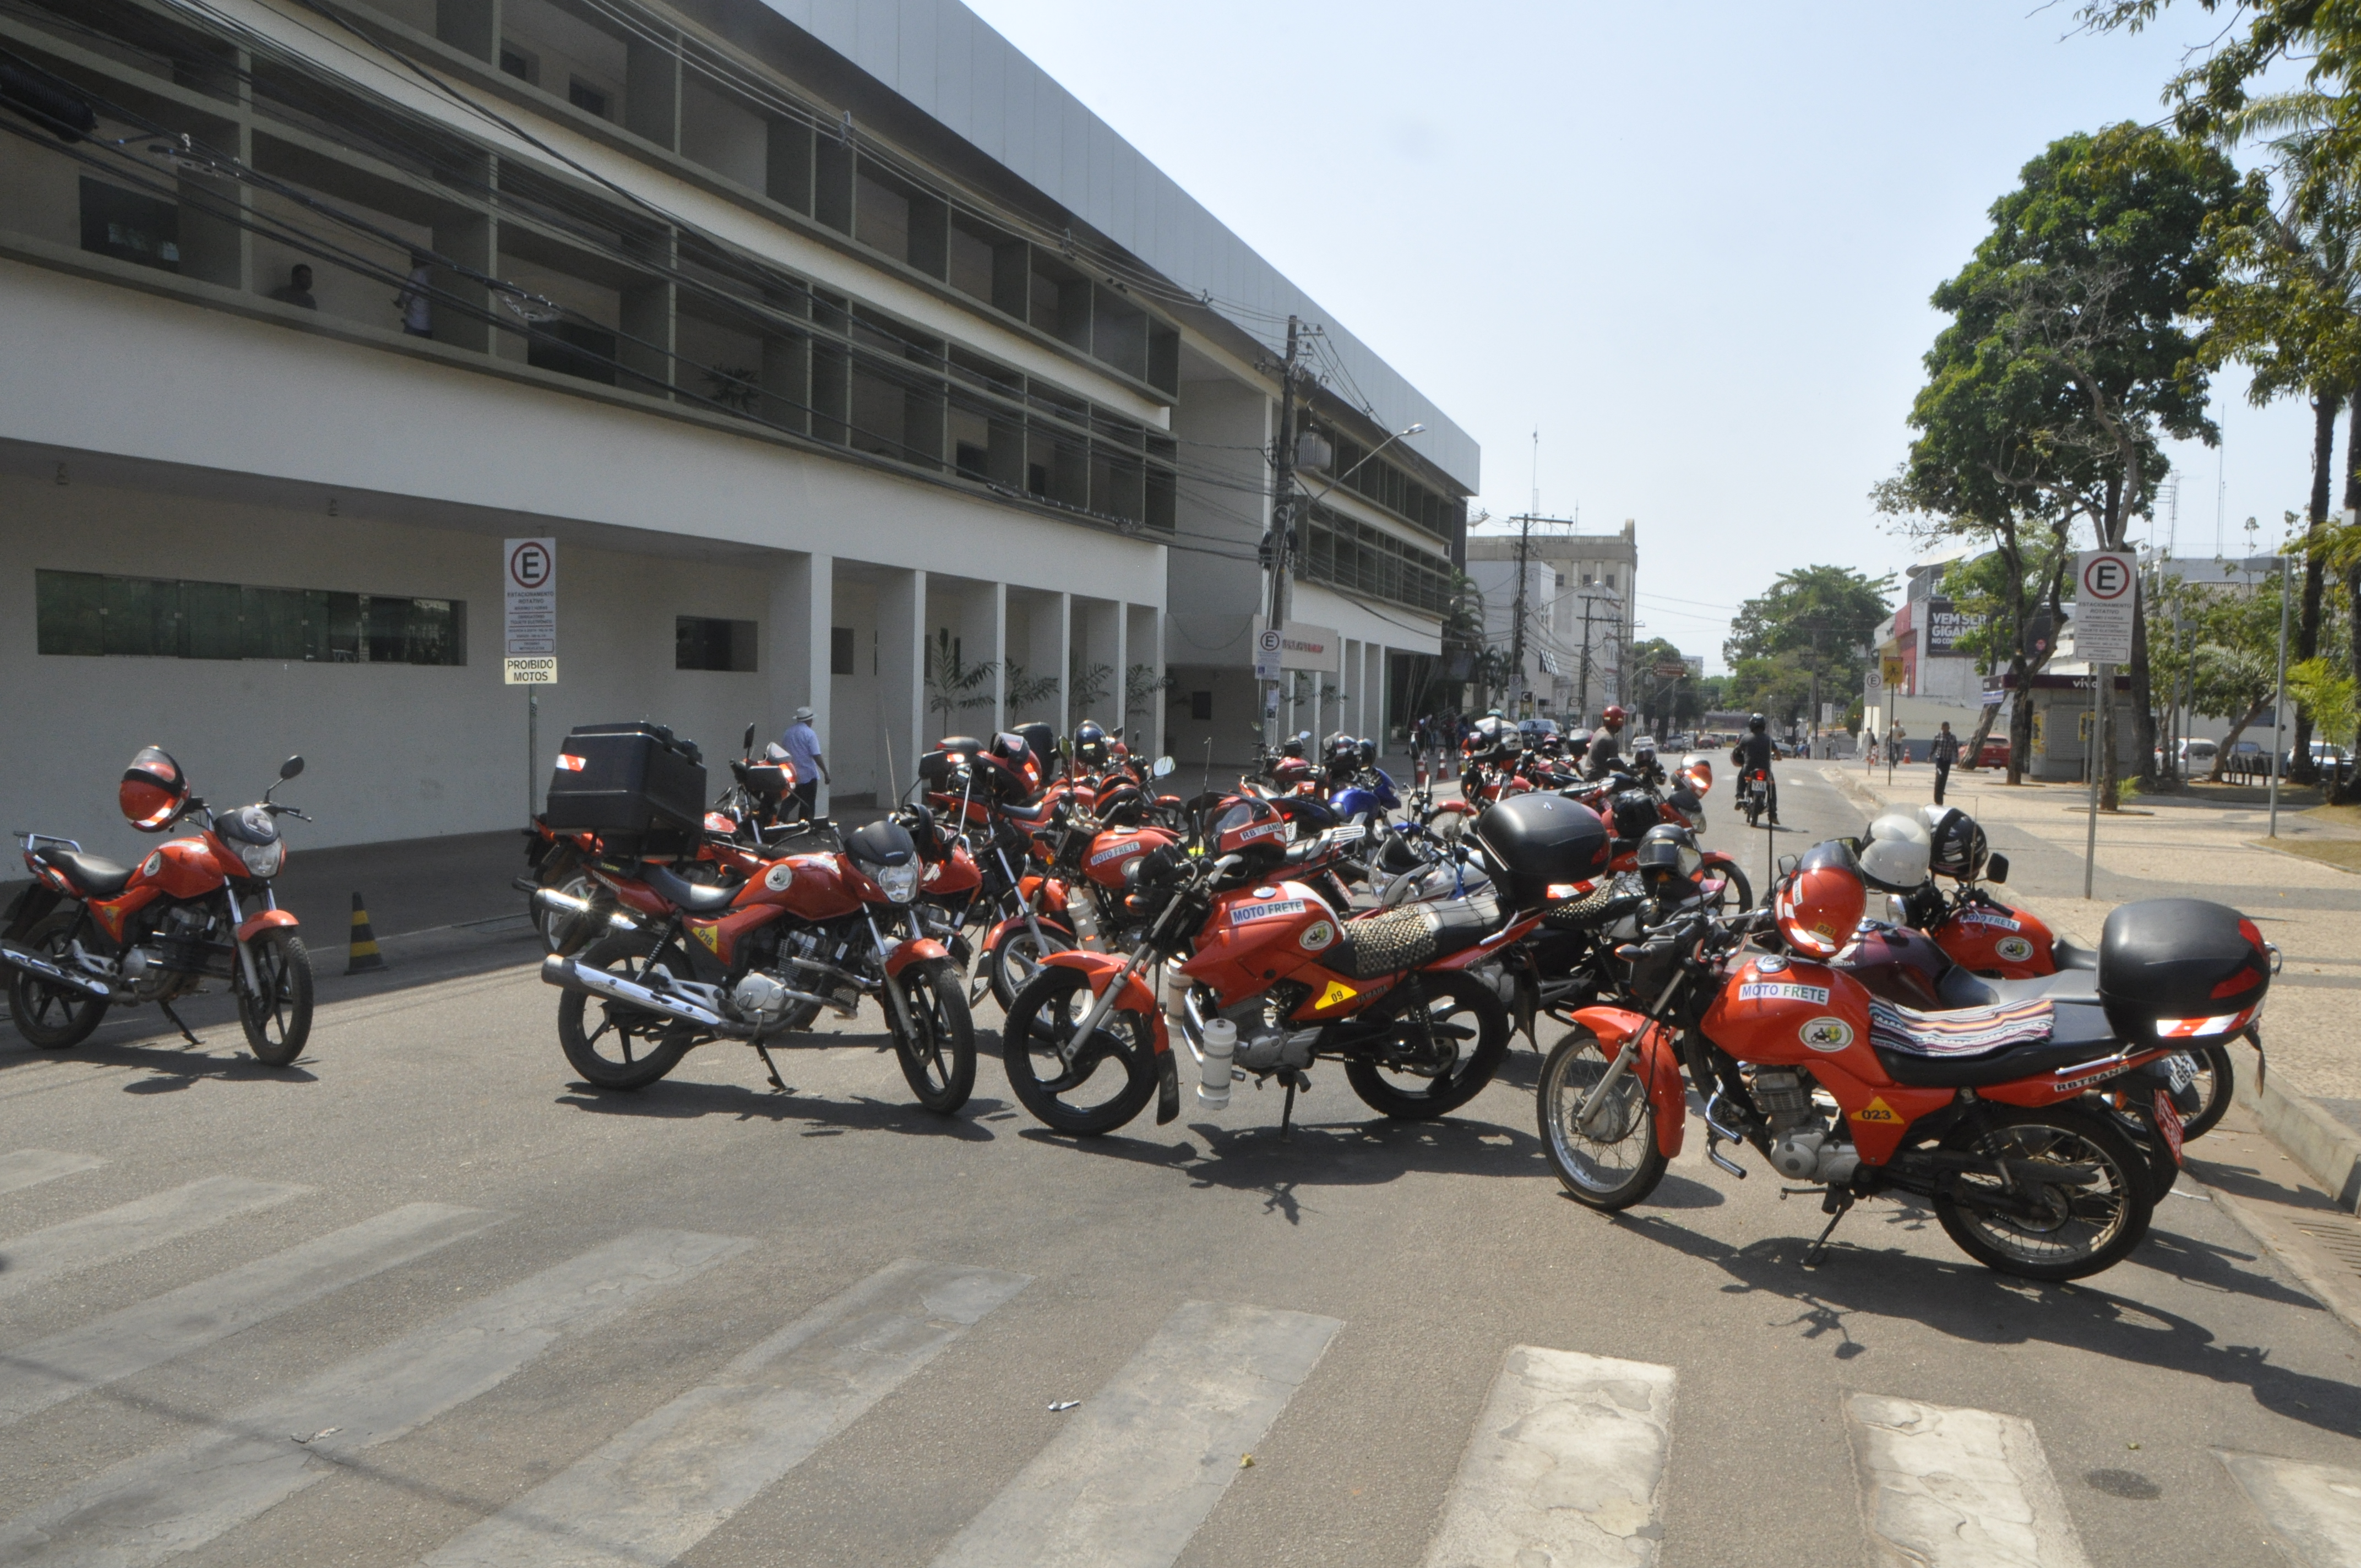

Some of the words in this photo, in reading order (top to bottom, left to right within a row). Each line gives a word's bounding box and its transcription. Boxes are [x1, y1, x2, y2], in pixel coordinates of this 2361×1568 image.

[523, 552, 540, 579] E
[2097, 565, 2117, 590] E
[1933, 613, 1960, 625] VEM
[1961, 613, 1987, 625] SER
[1265, 635, 1275, 647] E
[507, 659, 553, 670] PROIBIDO
[514, 672, 548, 682] MOTOS
[1092, 851, 1113, 864] MOTO
[1114, 842, 1139, 856] FRETE
[1233, 906, 1265, 923] MOTO
[1267, 901, 1303, 914] FRETE
[1818, 924, 1834, 936] 023
[1989, 917, 2018, 930] FRETE
[699, 929, 714, 946] 018
[1331, 990, 1343, 1002] 09
[1356, 984, 1388, 1003] YAMAHA
[1742, 984, 1778, 998] MOTO
[1783, 986, 1826, 1003] FRETE
[2057, 1065, 2130, 1091] RBTRANS
[1862, 1109, 1891, 1120] 023
